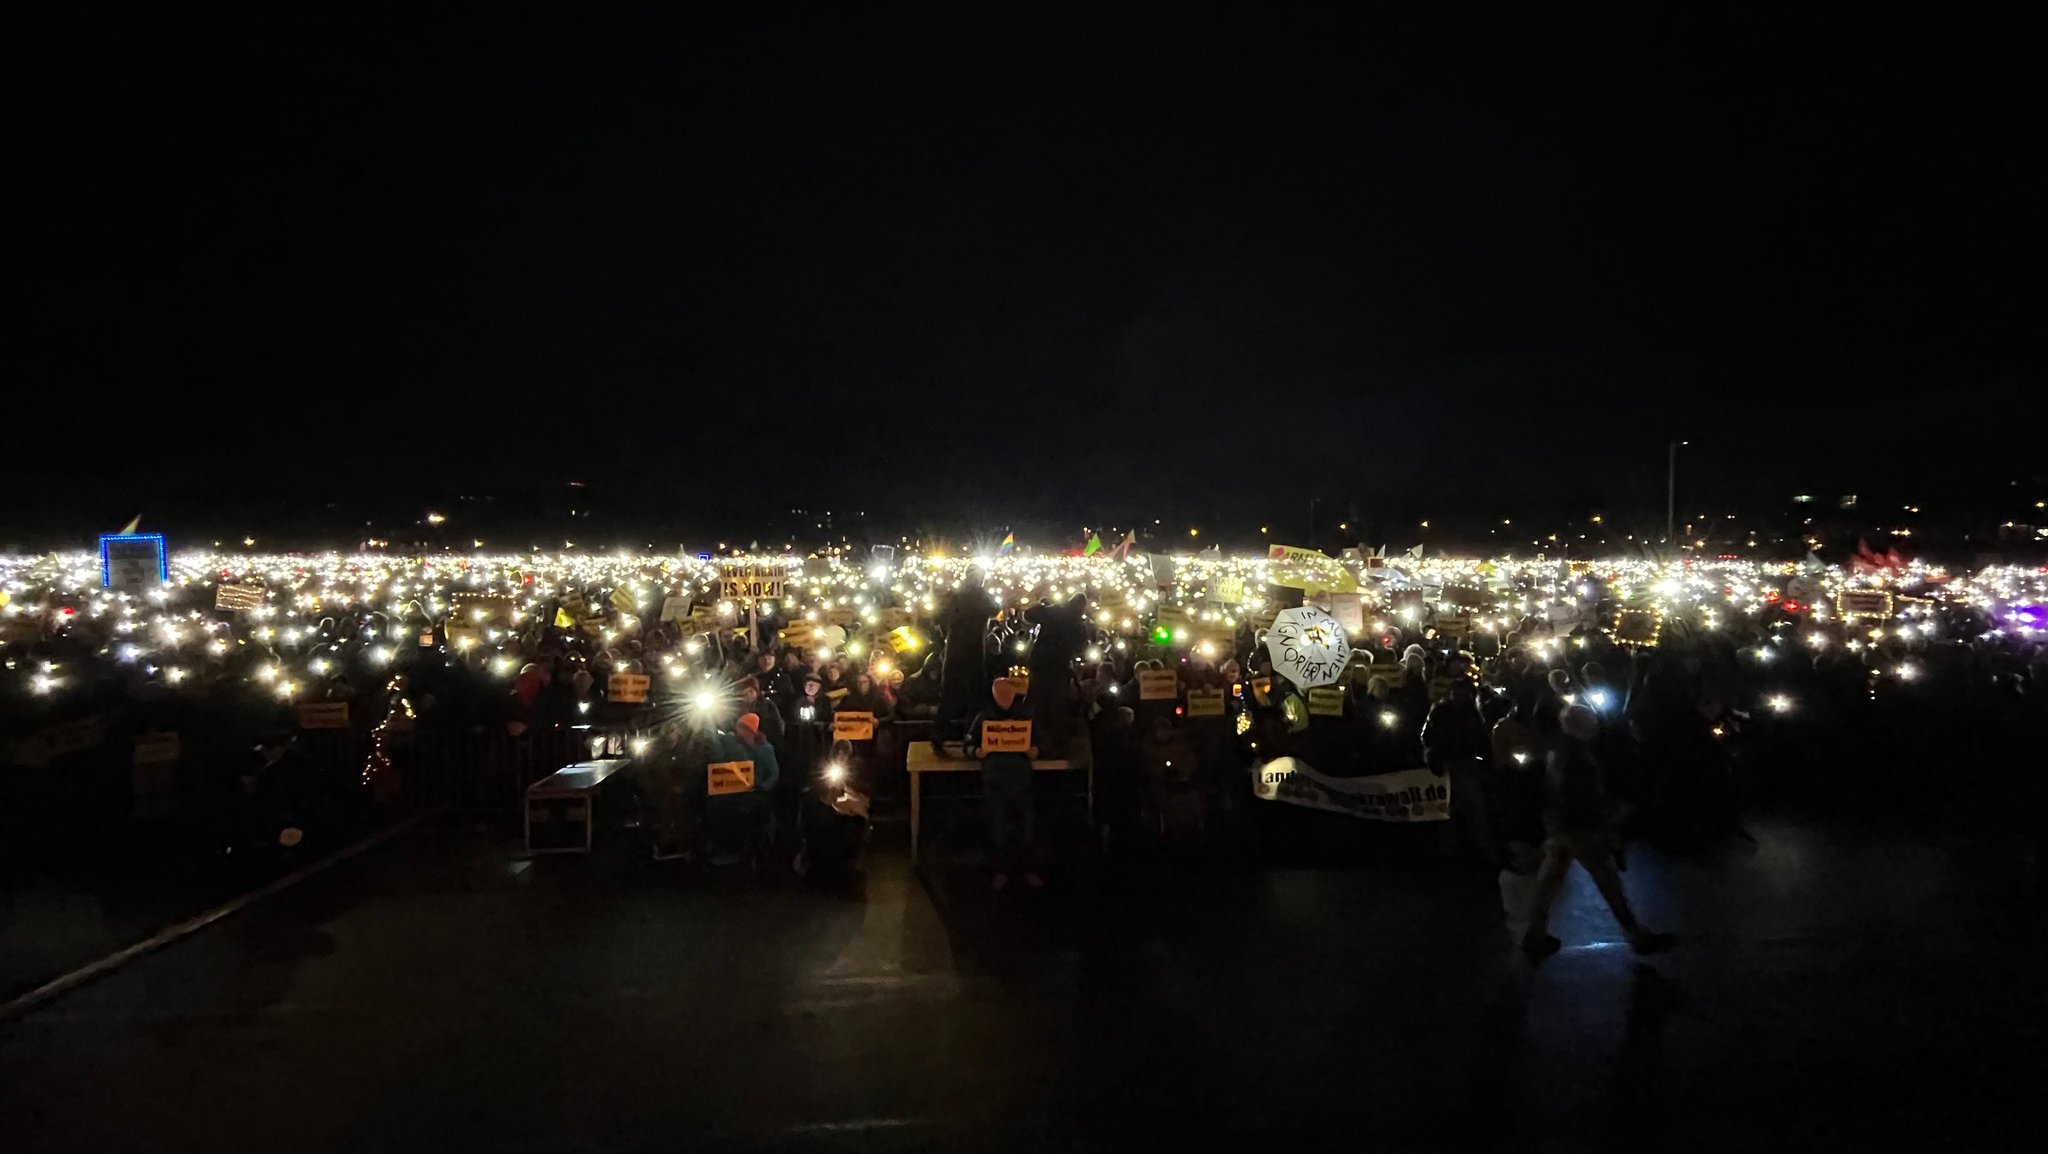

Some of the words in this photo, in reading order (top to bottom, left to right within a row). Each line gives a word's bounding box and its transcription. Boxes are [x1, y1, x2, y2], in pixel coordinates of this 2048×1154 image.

[721, 566, 752, 577] NEVER
[755, 566, 784, 577] AGAIN
[724, 582, 738, 597] IS
[743, 582, 781, 597] NOW!
[1301, 611, 1317, 619] IN
